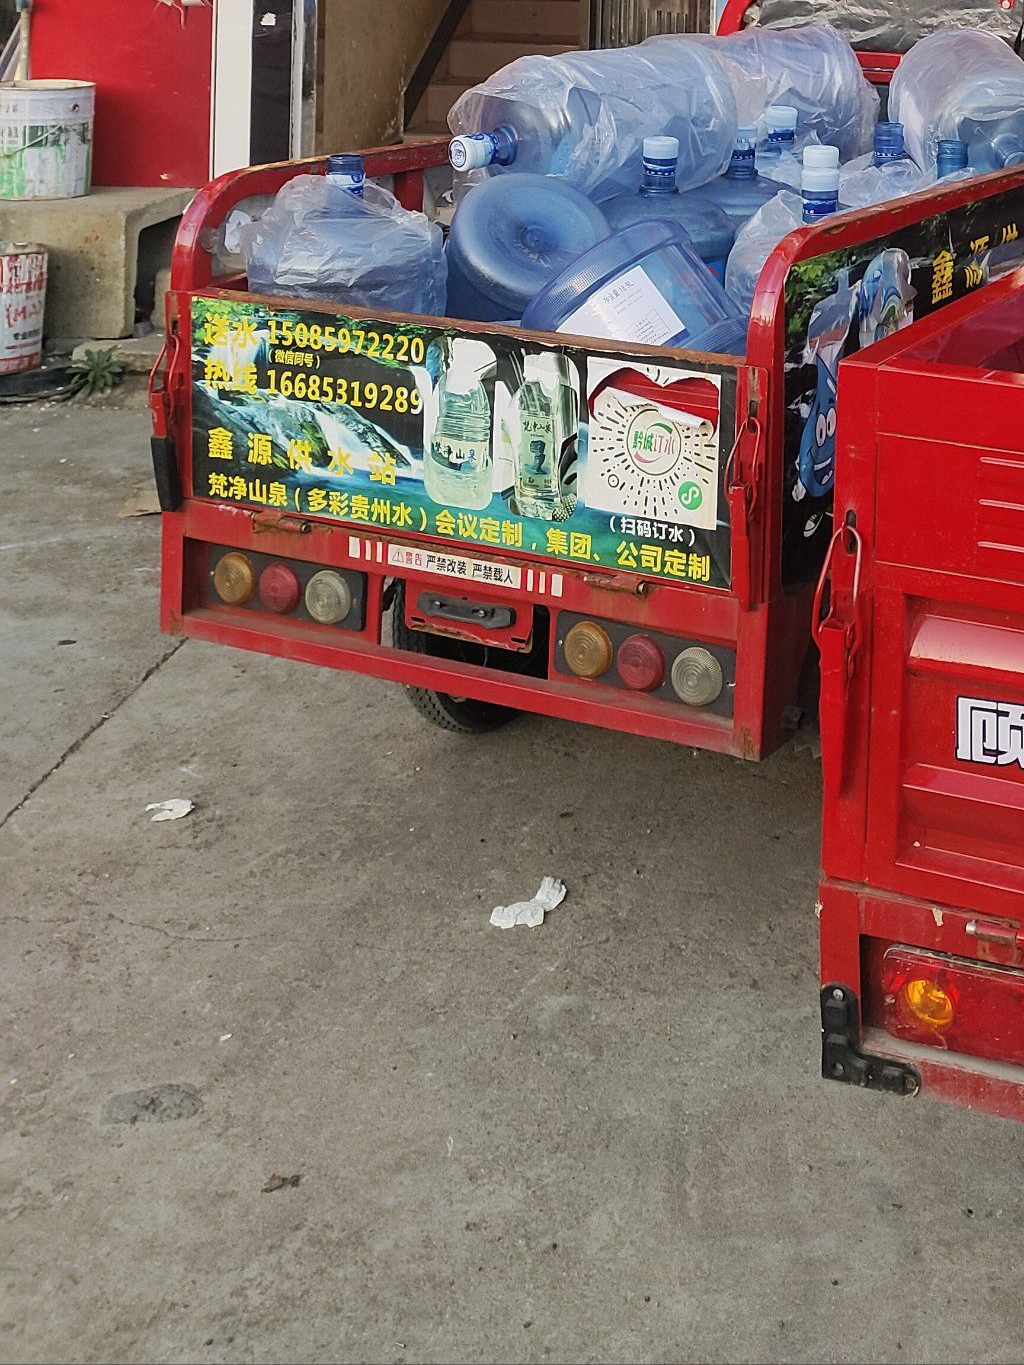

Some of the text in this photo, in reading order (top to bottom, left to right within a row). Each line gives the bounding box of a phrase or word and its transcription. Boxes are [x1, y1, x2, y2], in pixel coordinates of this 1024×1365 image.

[203, 312, 425, 364] 送水 15085972220
[203, 356, 424, 415] 热线 16685319289
[207, 426, 397, 486] 鑫源供水站
[426, 554, 467, 576] 严禁改装
[472, 563, 514, 585] 严禁载人
